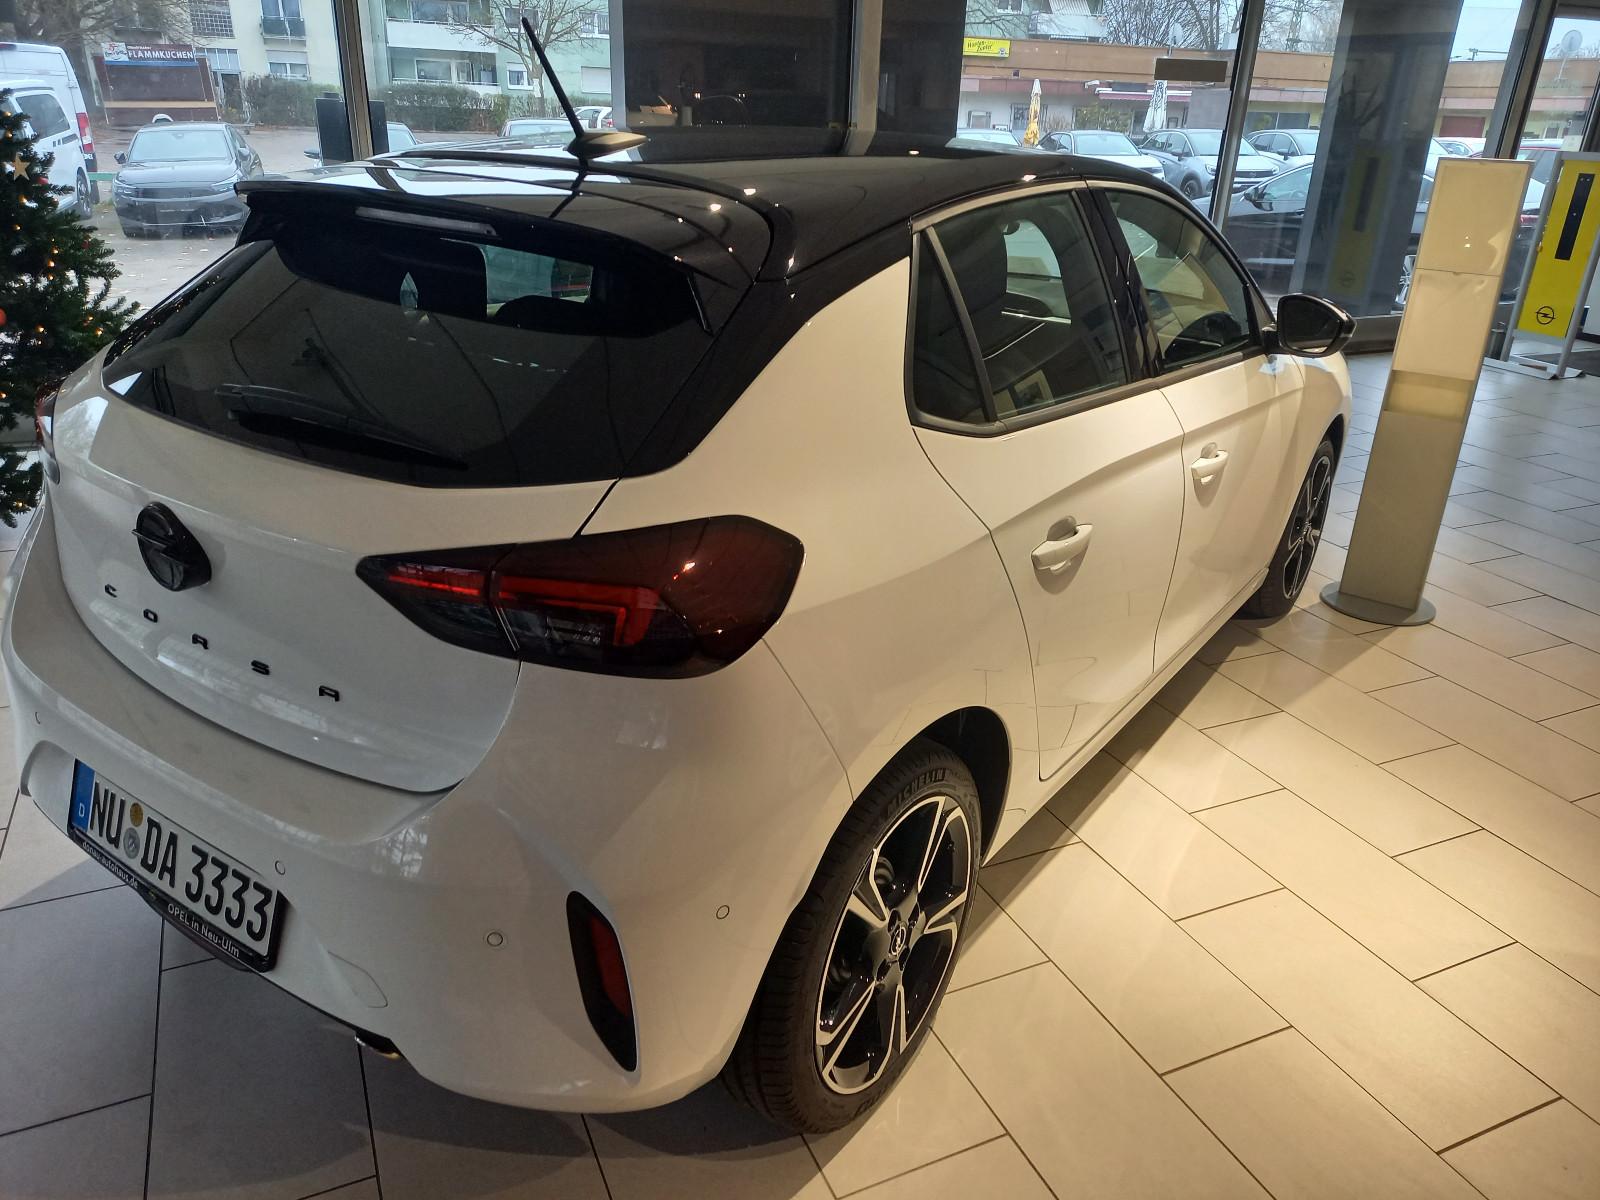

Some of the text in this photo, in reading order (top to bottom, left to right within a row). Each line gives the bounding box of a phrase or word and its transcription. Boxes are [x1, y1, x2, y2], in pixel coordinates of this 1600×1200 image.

[127, 50, 194, 59] FLAMMKUCHEN
[104, 584, 340, 702] CORSA
[78, 802, 86, 817] D
[887, 767, 946, 816] MICHELIN
[89, 780, 273, 942] NU DA 3333
[167, 903, 240, 958] OPEL in Neu-Ulm
